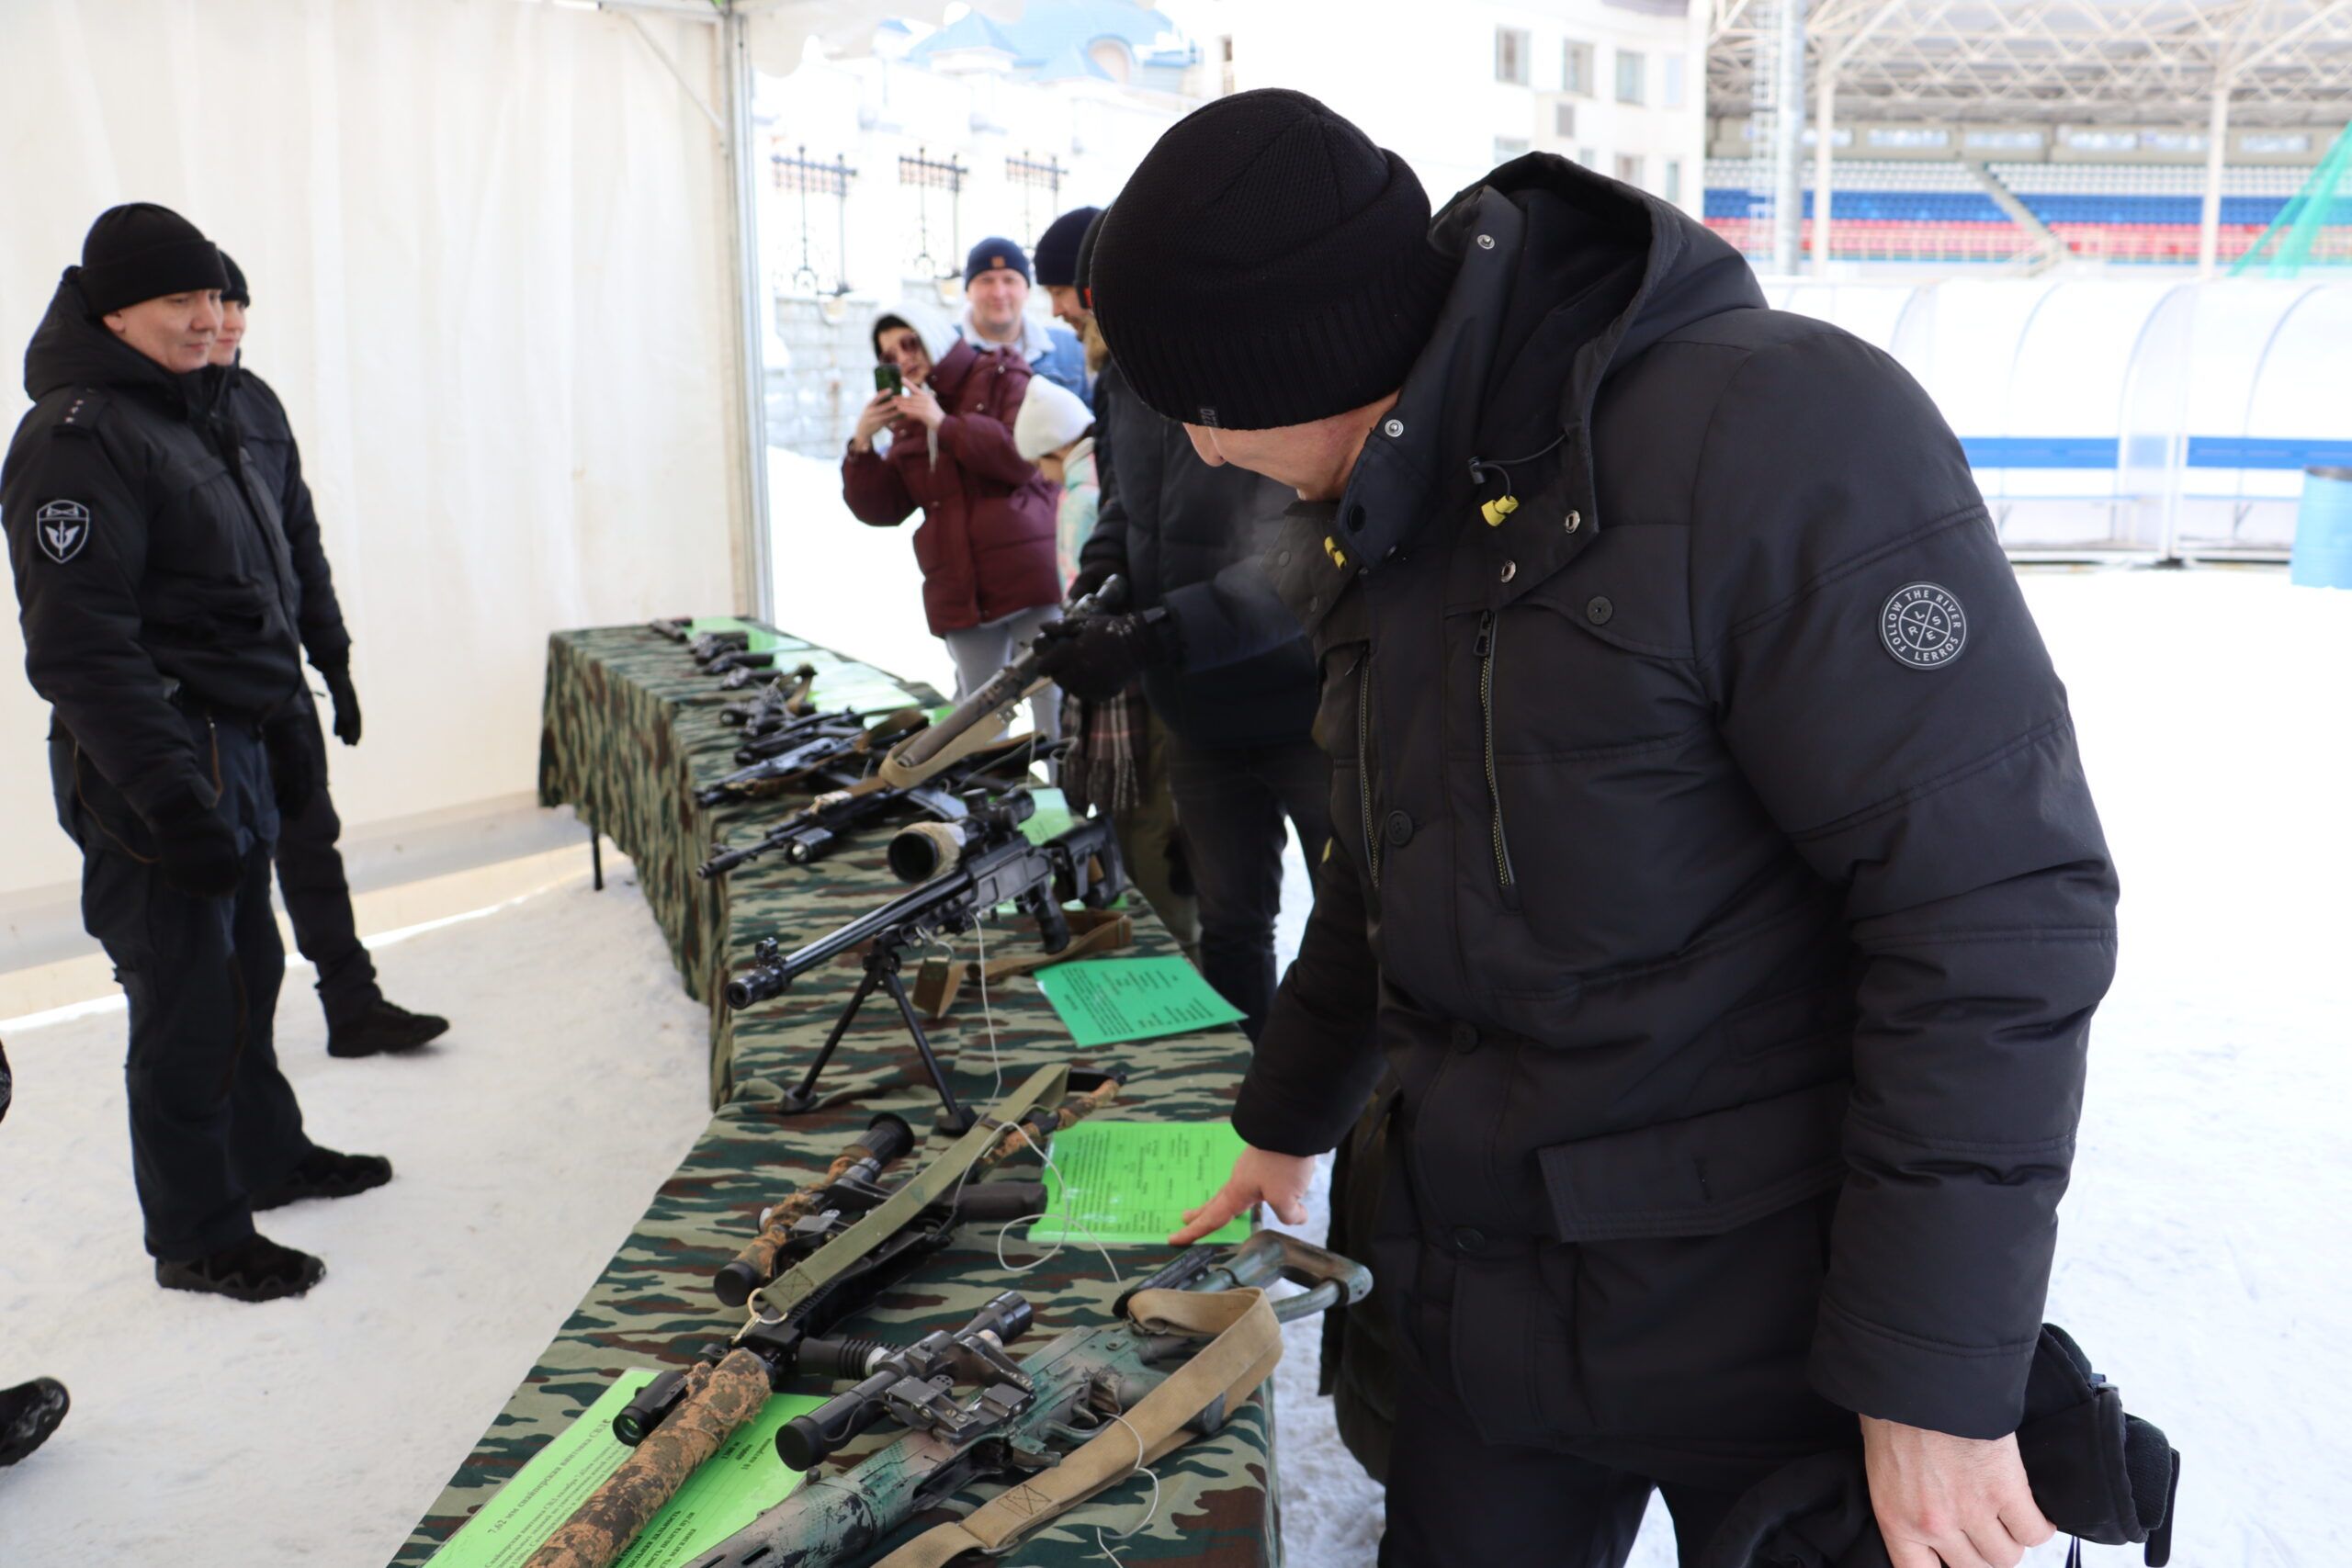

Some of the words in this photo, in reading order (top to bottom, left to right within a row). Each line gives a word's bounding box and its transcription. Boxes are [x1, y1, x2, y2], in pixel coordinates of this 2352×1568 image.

[1887, 601, 1906, 652] FOLLOW
[1905, 590, 1929, 602] THE
[1935, 594, 1962, 628] RIVER
[1914, 611, 1925, 620] L
[1932, 615, 1941, 626] S
[1907, 626, 1918, 636] R
[1926, 630, 1936, 640] E
[1914, 637, 1959, 661] LERROS
[517, 1466, 562, 1507] снайперская
[560, 1438, 593, 1466] винтовка
